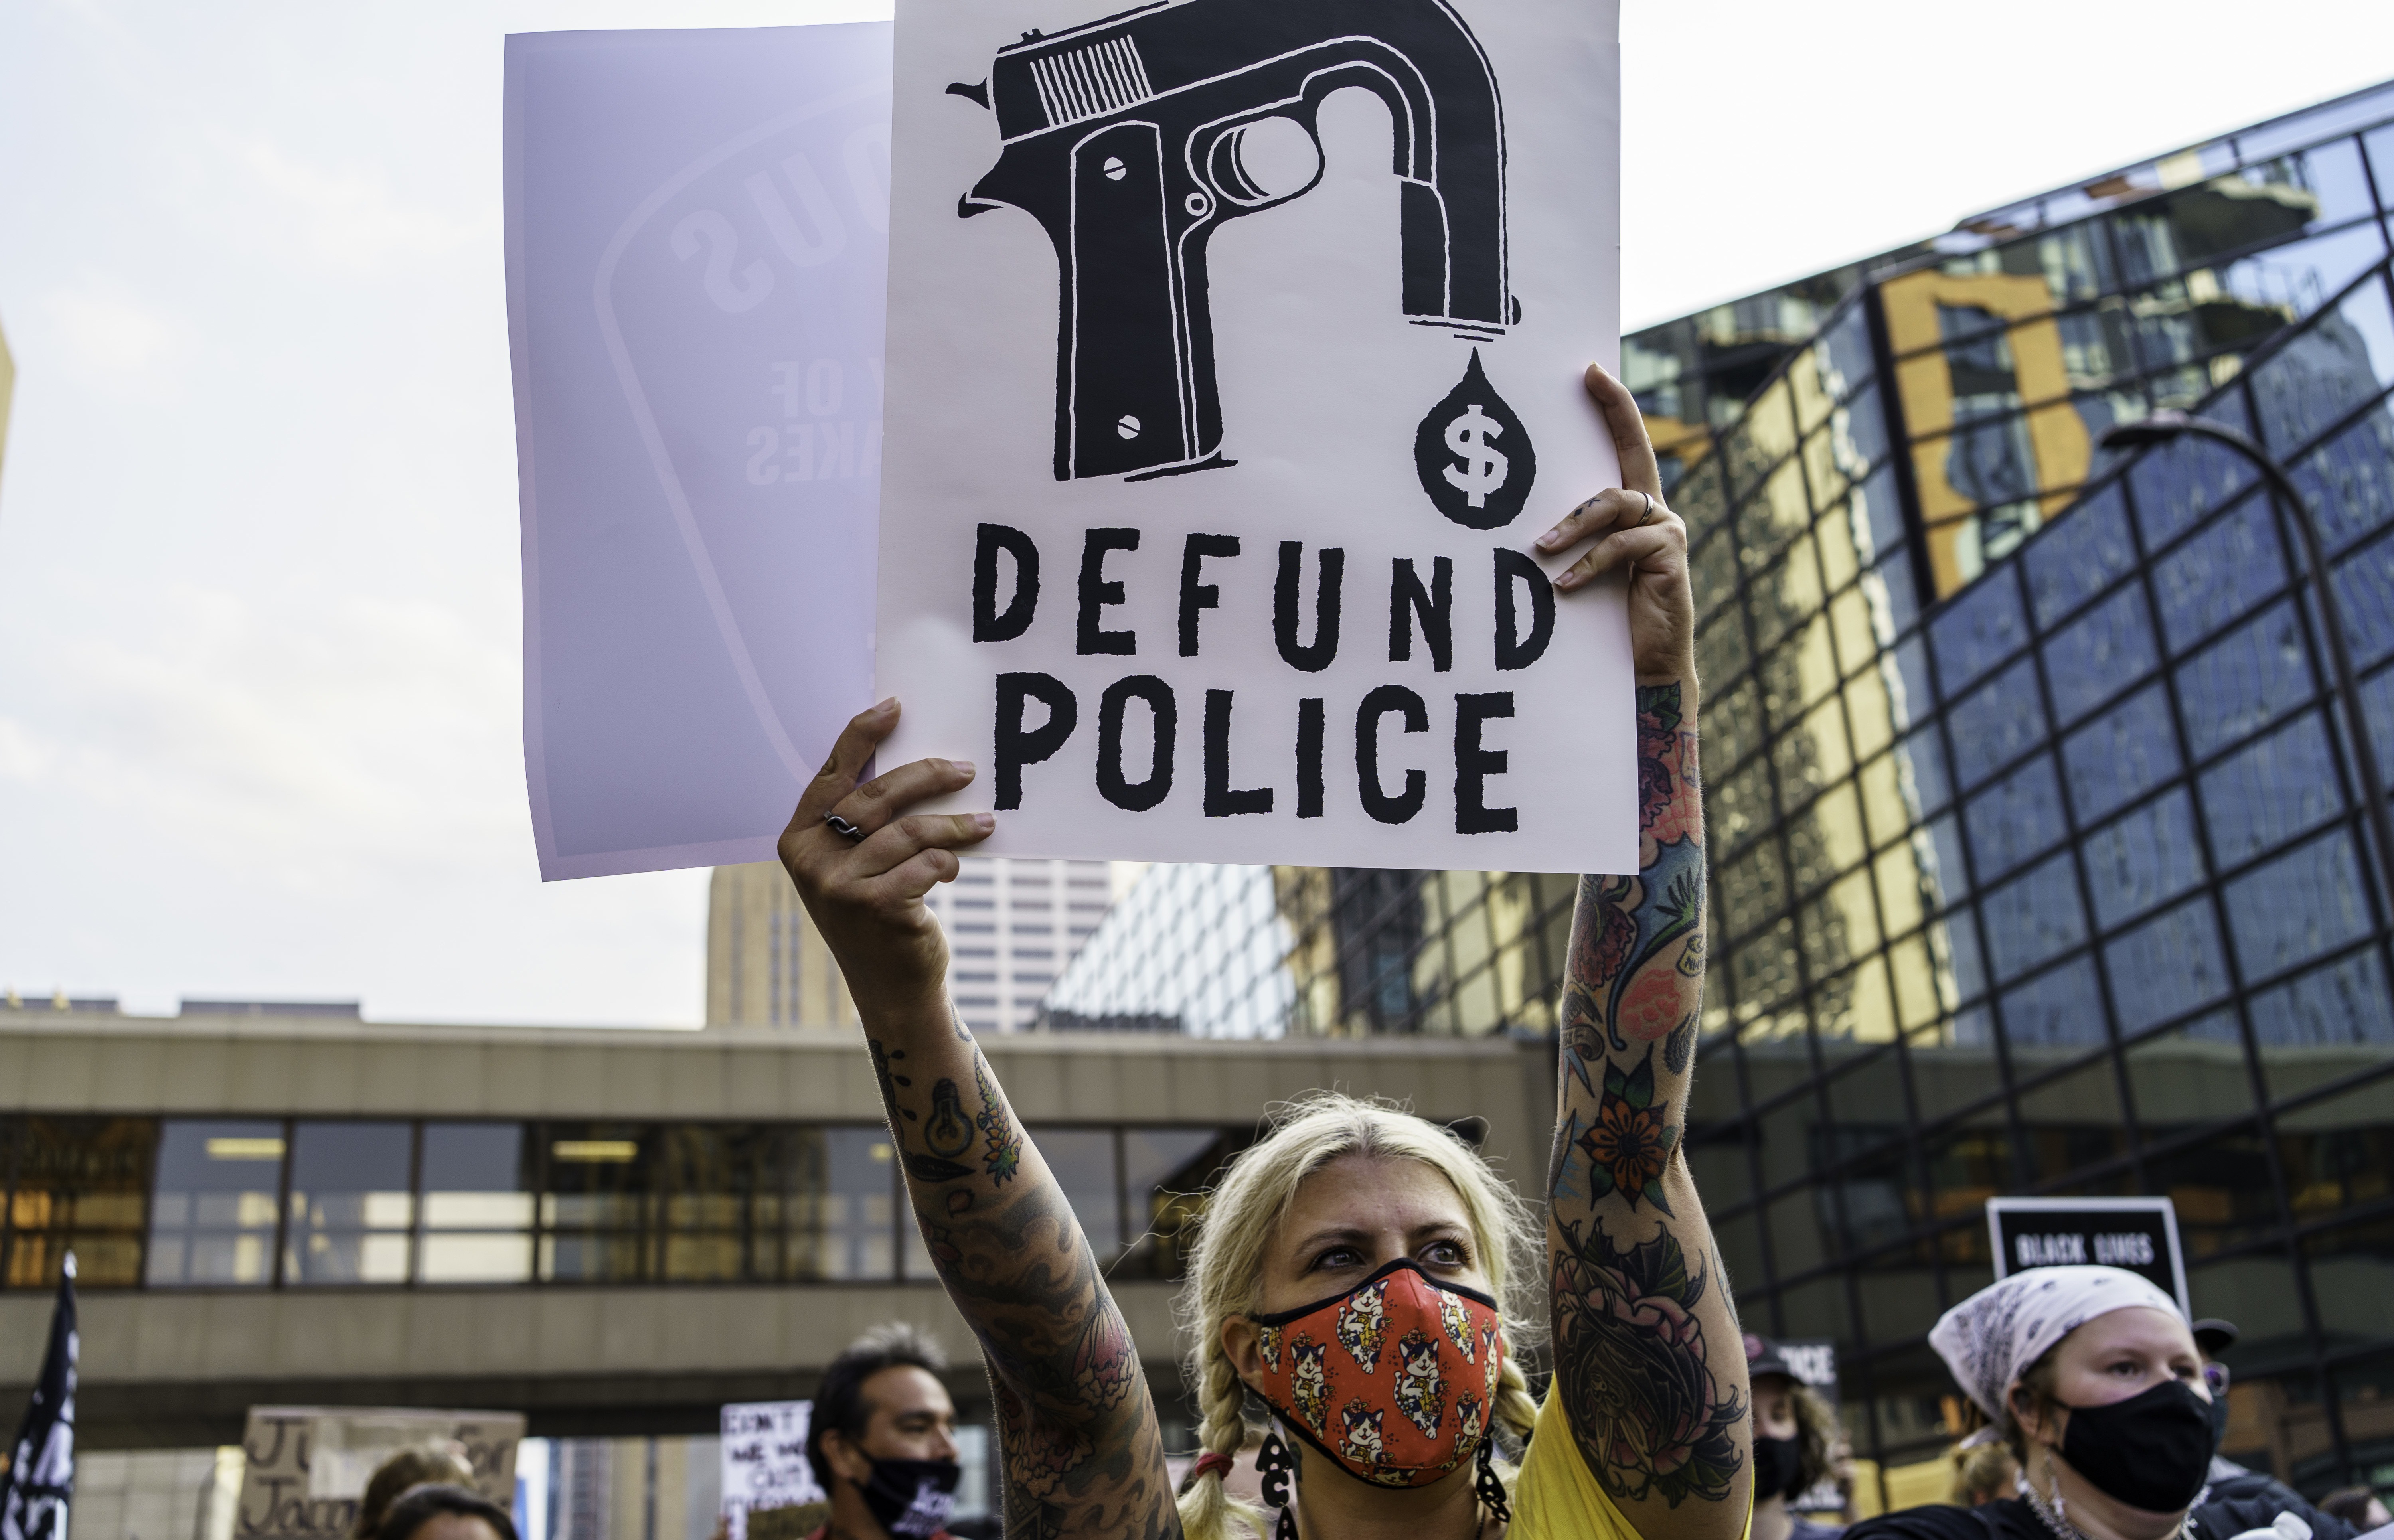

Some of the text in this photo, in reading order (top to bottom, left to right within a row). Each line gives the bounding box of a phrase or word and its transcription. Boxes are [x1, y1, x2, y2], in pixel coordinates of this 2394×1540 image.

[972, 523, 1556, 673] DEFUND
[994, 672, 1518, 835] POLICE
[2015, 1231, 2155, 1267] BLACK LIVES
